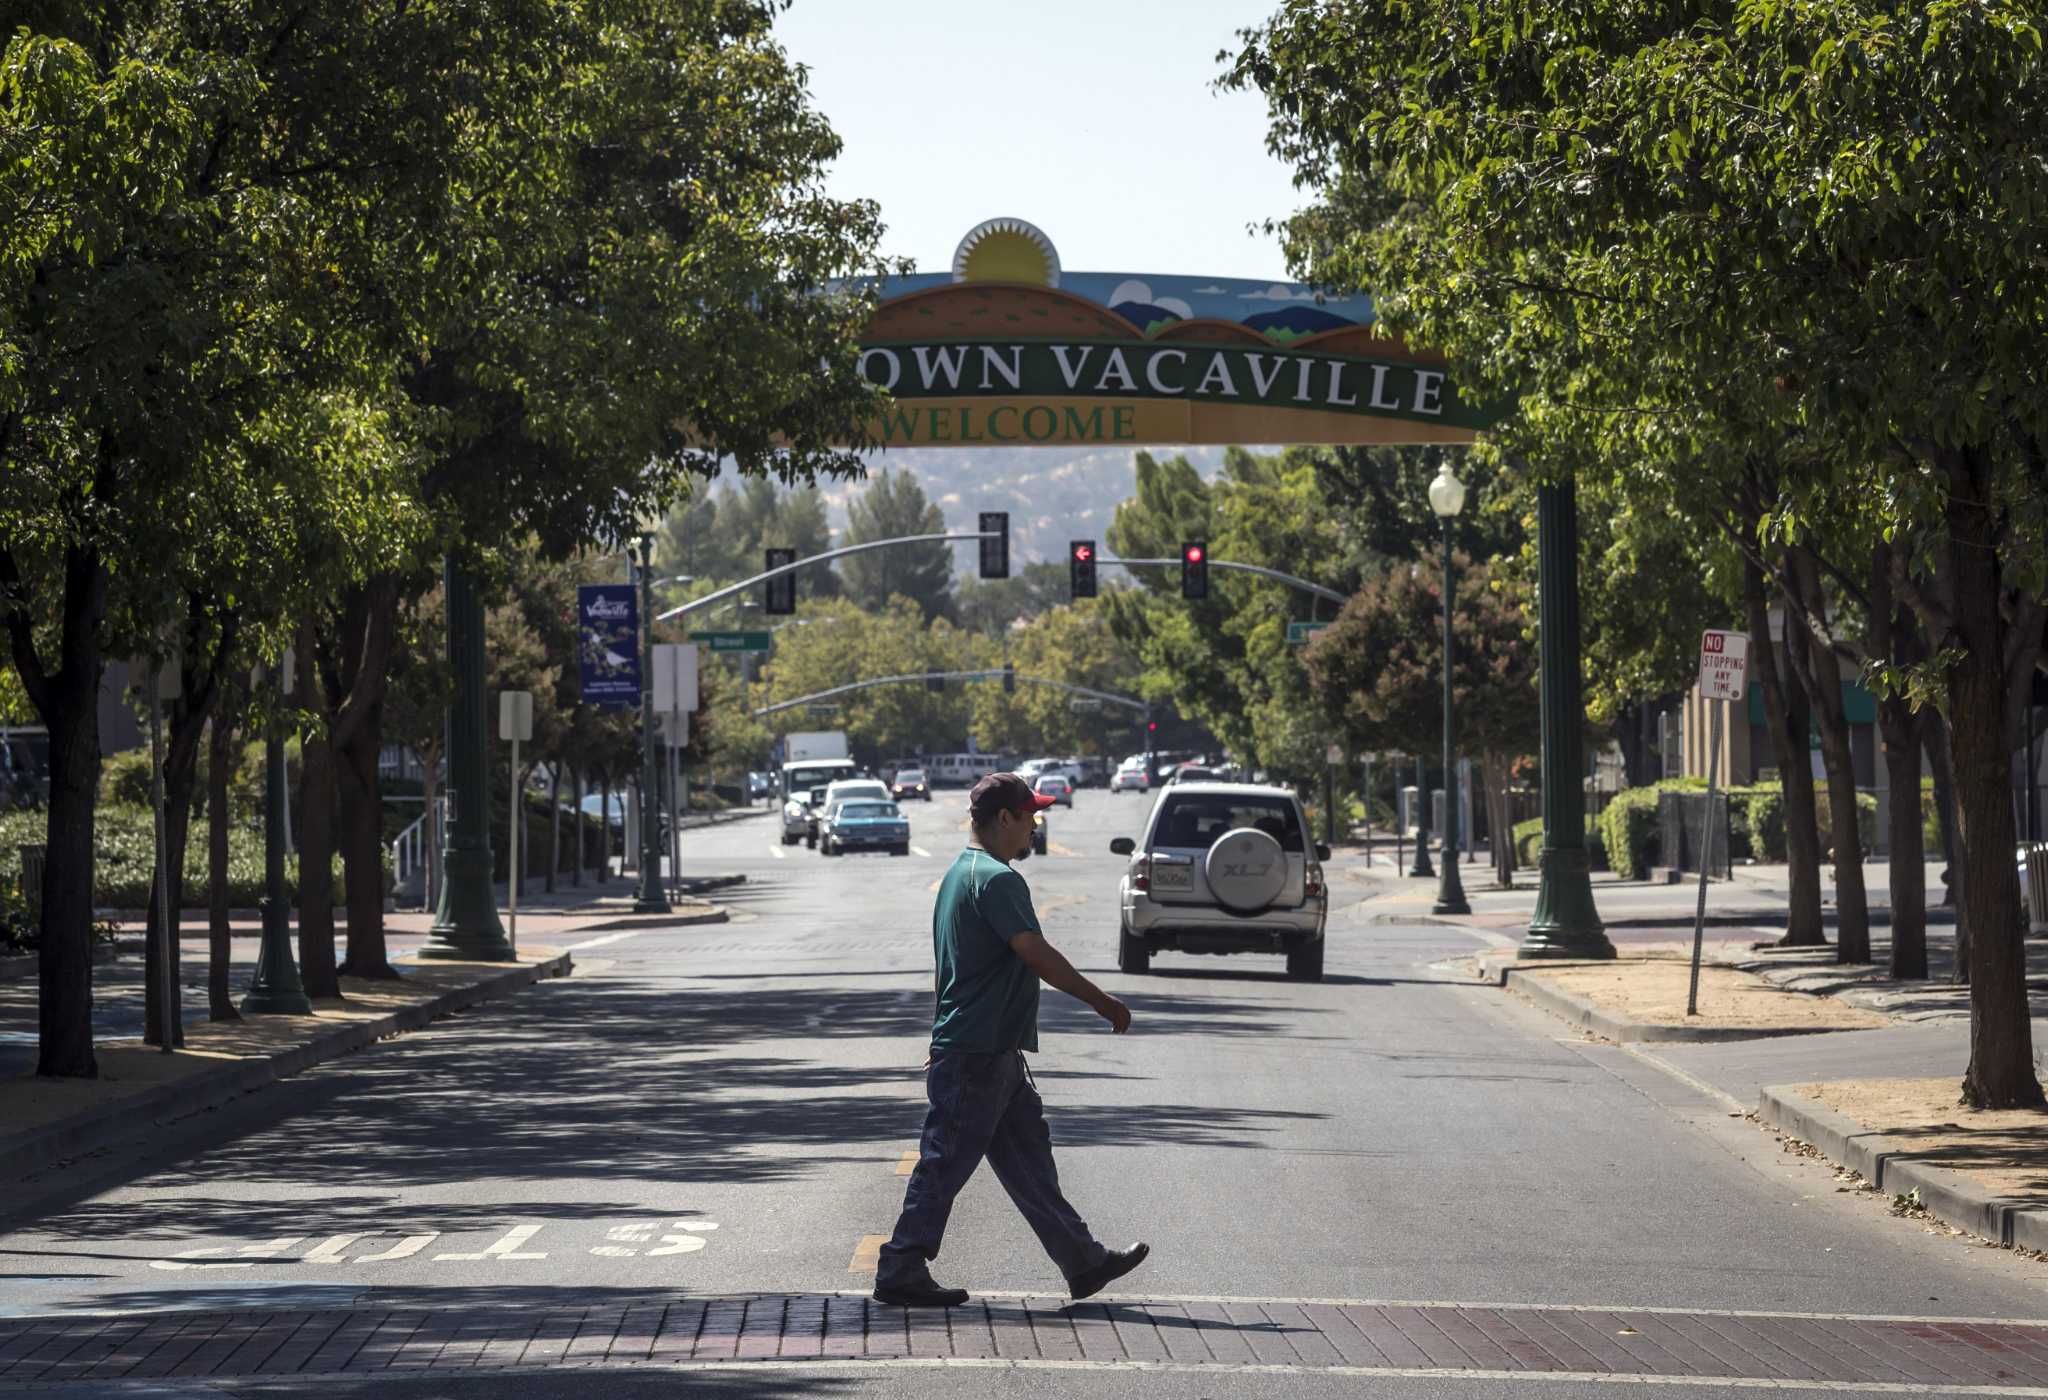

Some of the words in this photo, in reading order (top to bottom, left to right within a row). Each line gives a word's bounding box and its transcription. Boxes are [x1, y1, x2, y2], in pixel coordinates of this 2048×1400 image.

[820, 345, 1024, 391] OWN
[1049, 345, 1445, 415] VACAVILLE
[880, 405, 1137, 441] WELCOME
[1705, 635, 1722, 651] NO
[1703, 655, 1744, 671] STOPPING
[1715, 670, 1731, 681] ANY
[1713, 682, 1730, 693] TIME
[149, 1221, 720, 1270] STOP
